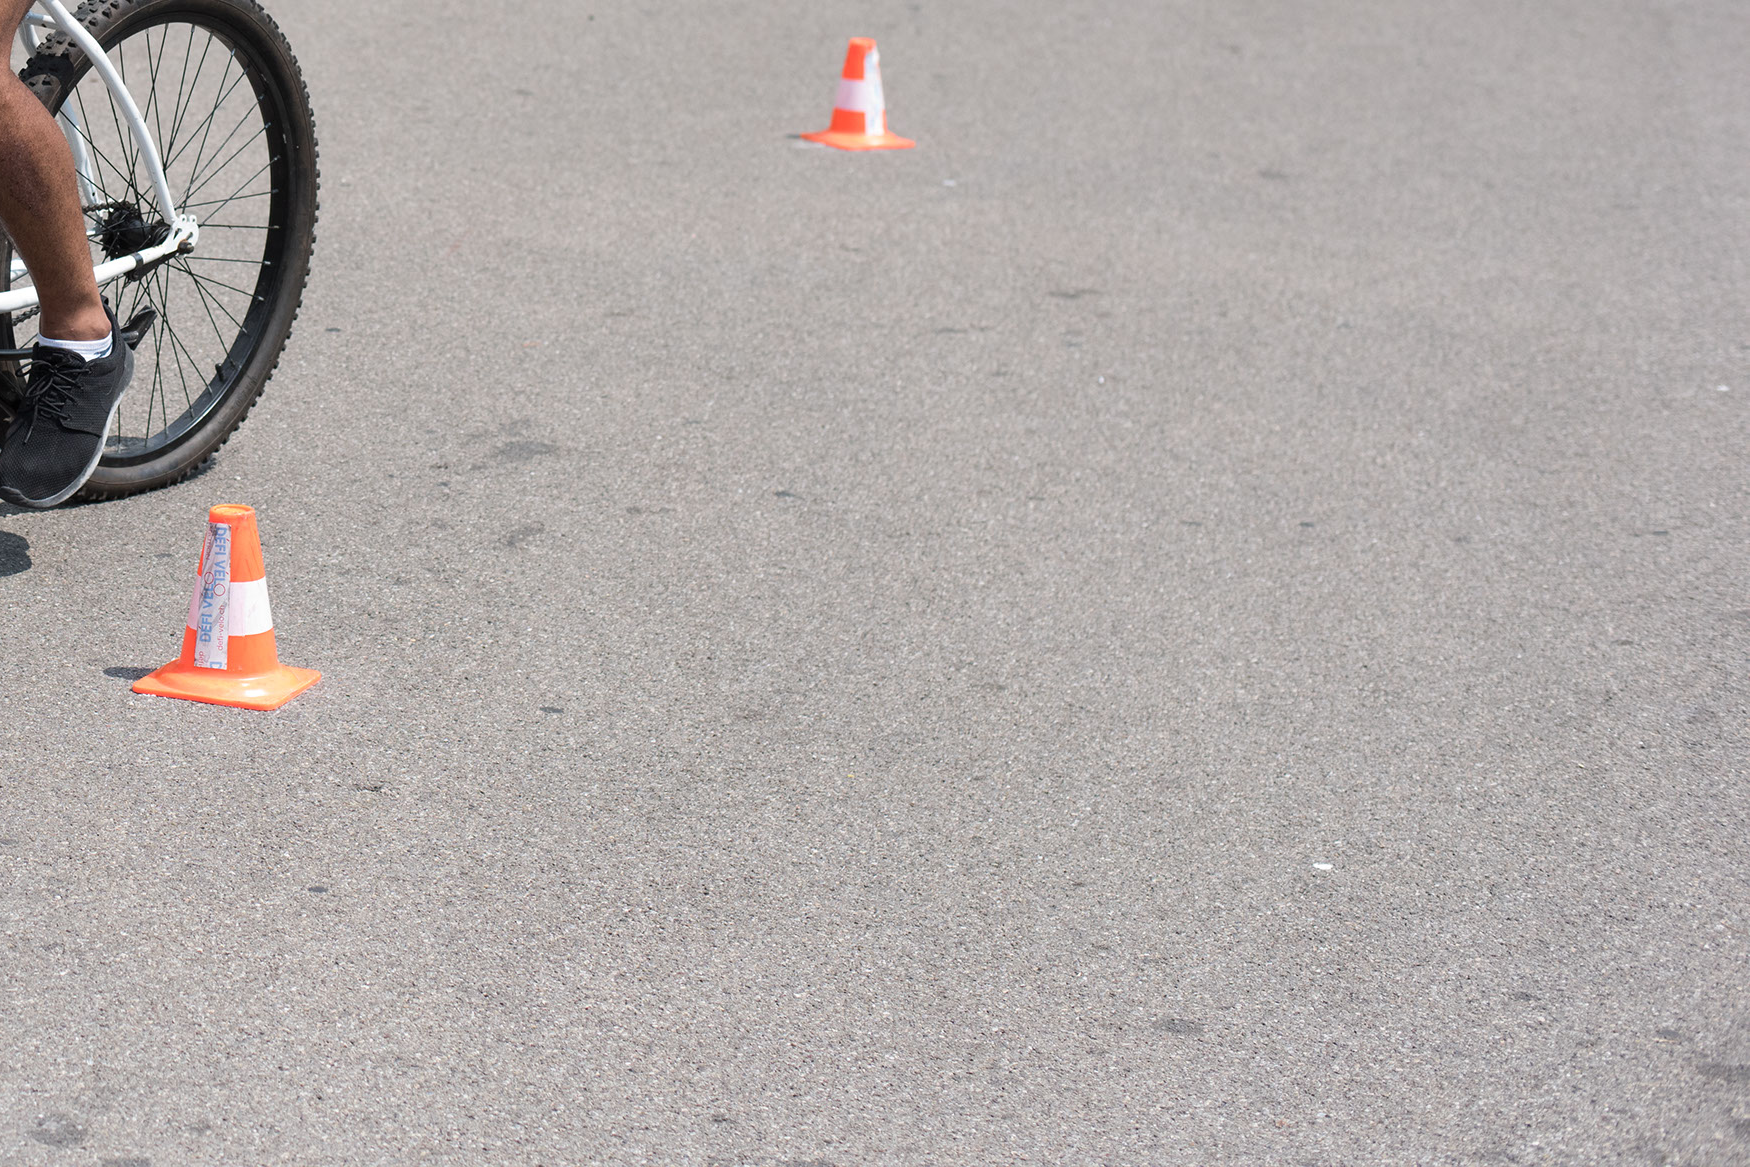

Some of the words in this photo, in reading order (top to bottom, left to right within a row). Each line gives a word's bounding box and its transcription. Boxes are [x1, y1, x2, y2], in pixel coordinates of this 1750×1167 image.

[215, 527, 230, 556] DÉFI
[213, 560, 229, 596] VÉLO
[198, 613, 212, 642] DÉFI
